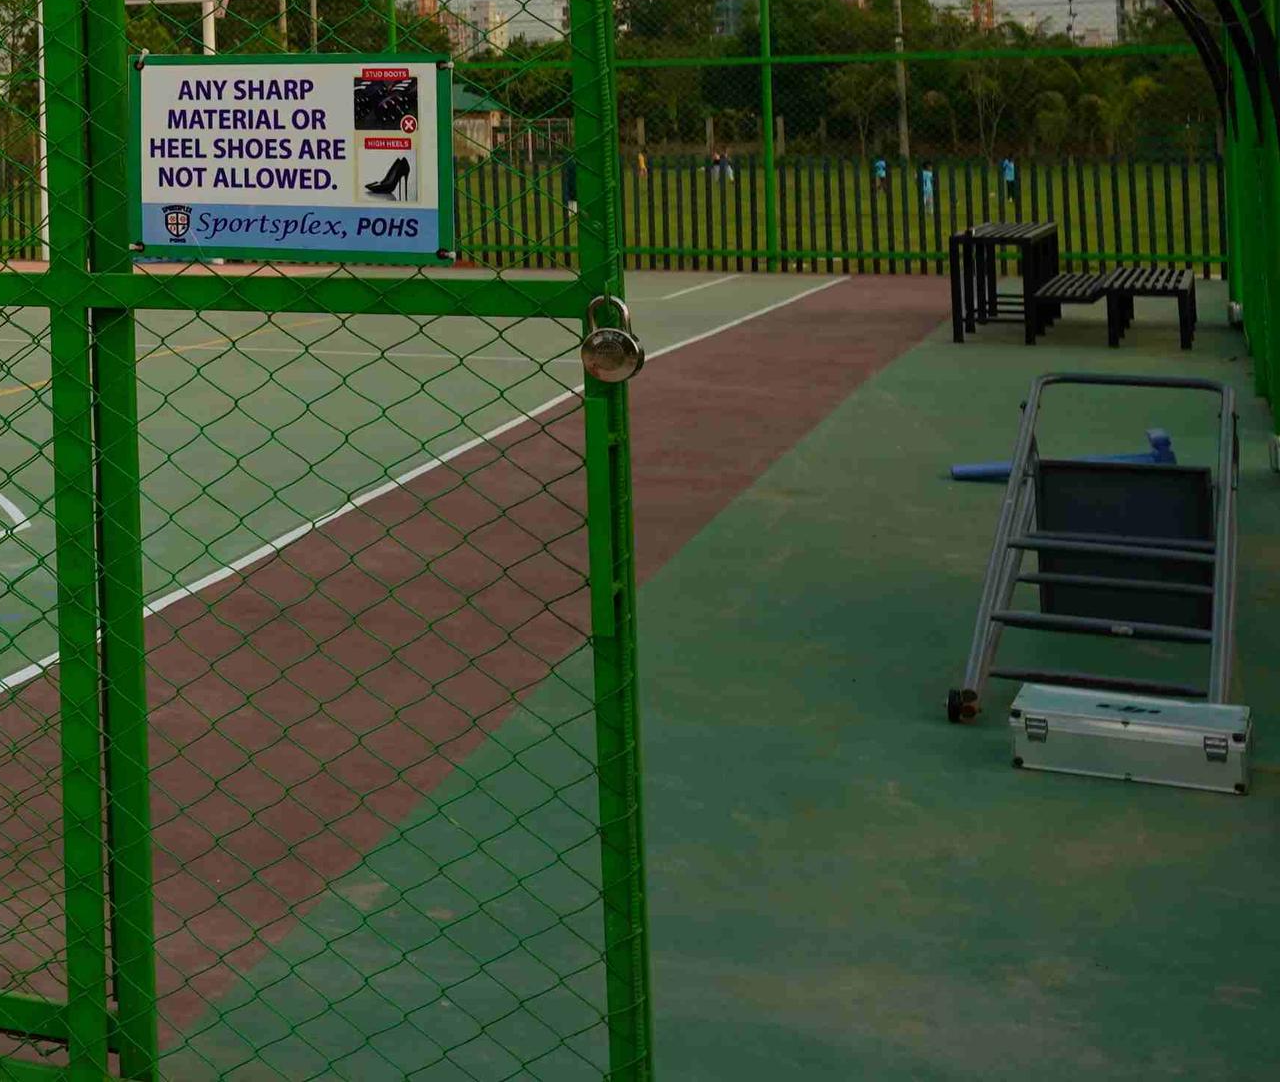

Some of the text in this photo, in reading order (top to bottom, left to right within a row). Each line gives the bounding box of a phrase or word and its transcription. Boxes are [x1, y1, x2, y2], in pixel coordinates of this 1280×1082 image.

[178, 79, 314, 101] ANY SHARP
[167, 108, 327, 131] MATERIAL OR
[150, 138, 346, 161] HEEL SHOES ARE
[386, 140, 409, 148] HEELS
[158, 167, 338, 191] NOT ALLOWED.
[196, 212, 419, 241] Sportsplex, POHS
